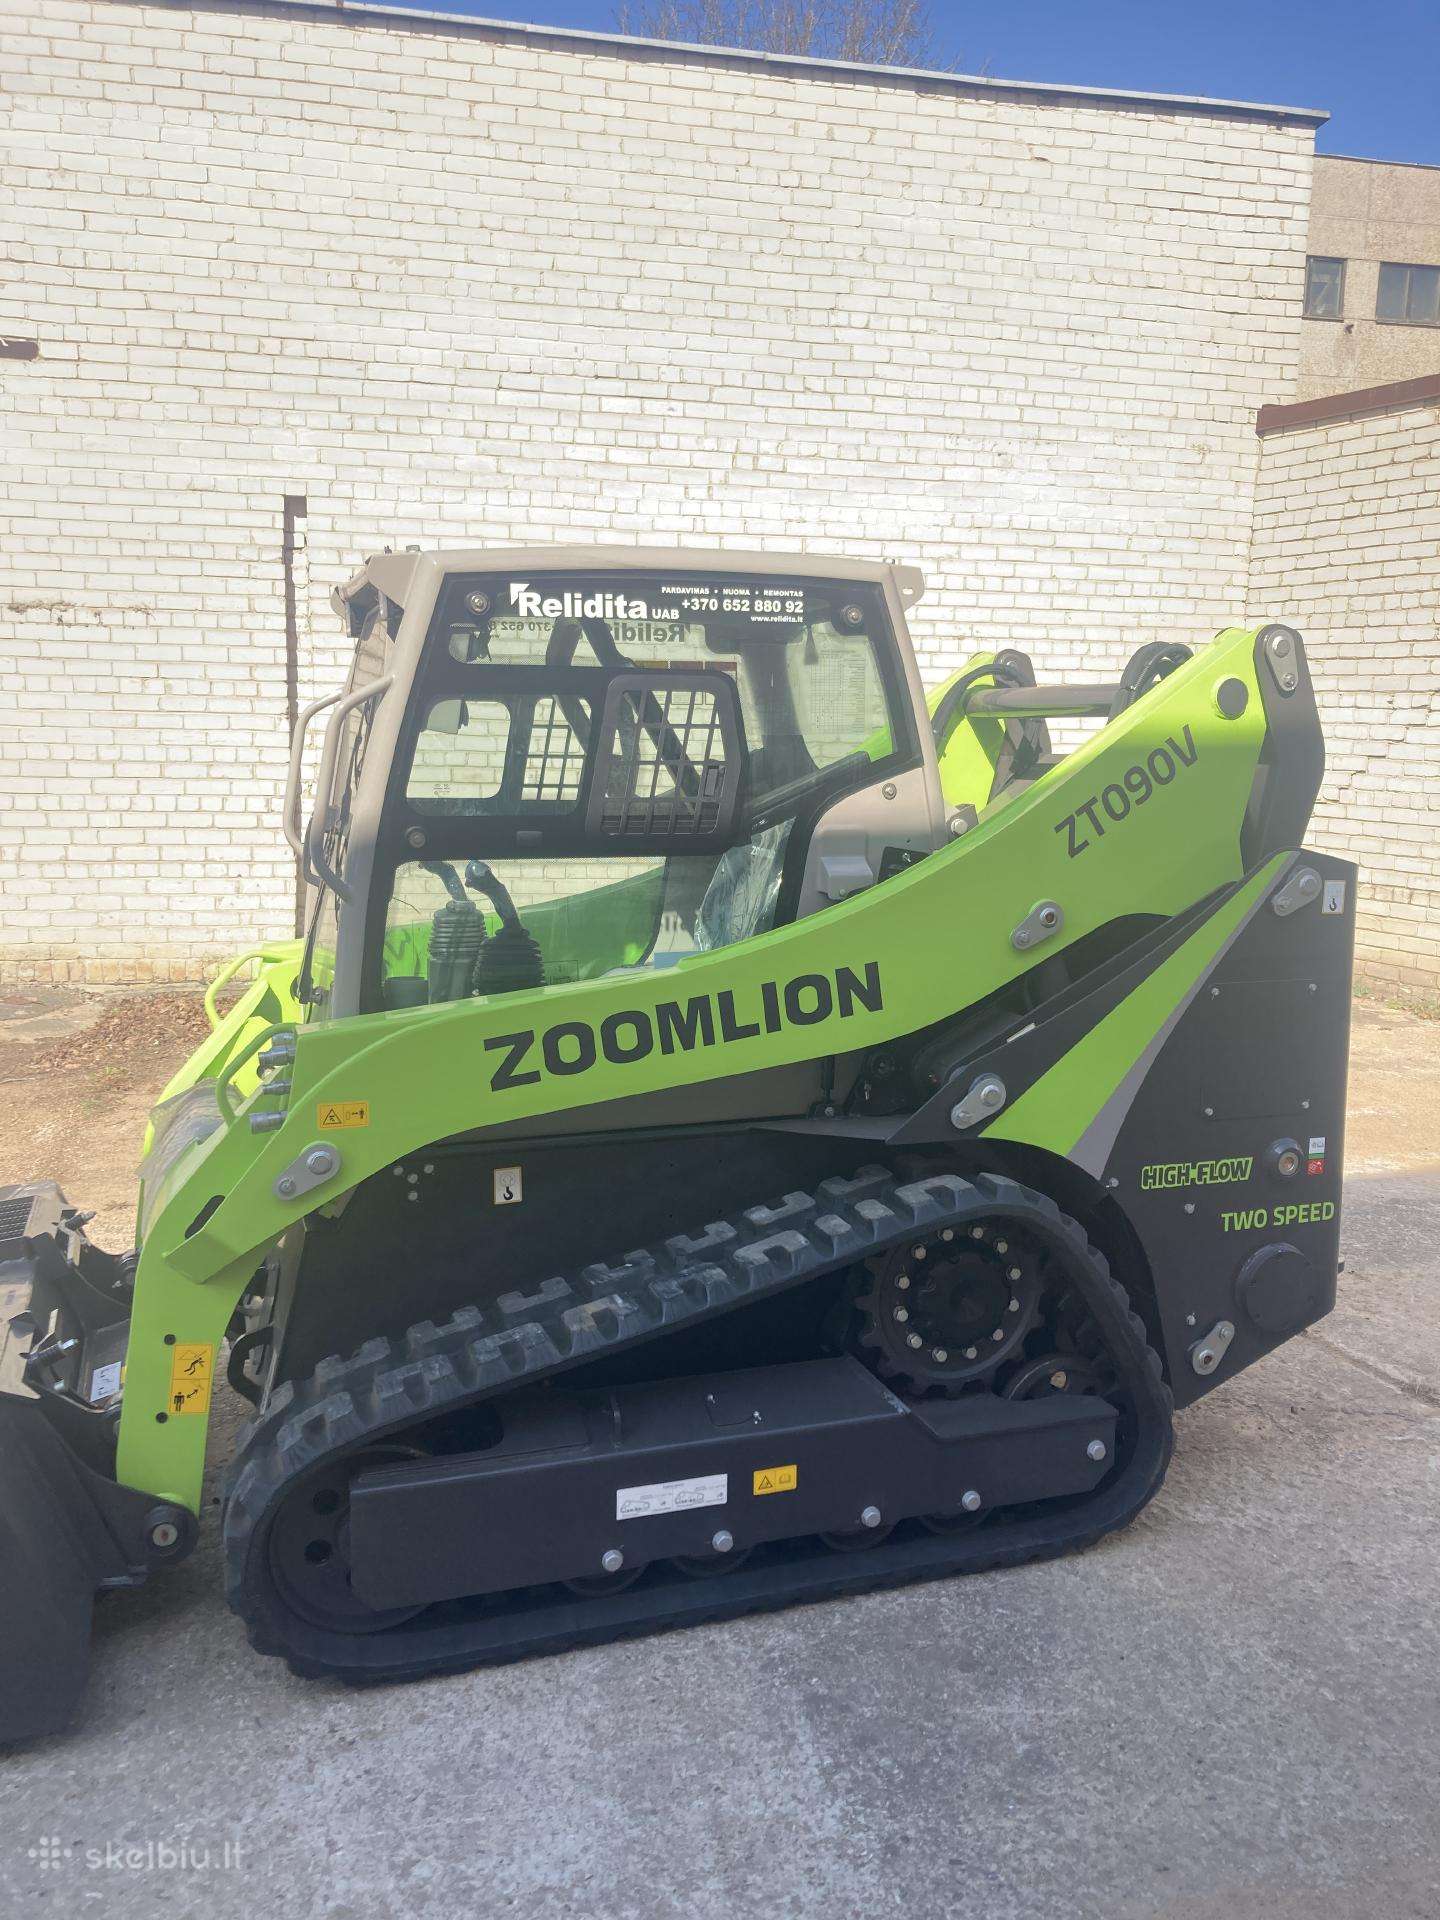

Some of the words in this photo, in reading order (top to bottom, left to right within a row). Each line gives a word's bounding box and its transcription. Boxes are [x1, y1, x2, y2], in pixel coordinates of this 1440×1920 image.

[518, 591, 648, 619] Relidita
[652, 608, 680, 620] UAB
[661, 586, 710, 595] PARDAVIMAS
[723, 588, 751, 596] NUOMA
[763, 589, 804, 597] REMONTAS
[682, 598, 719, 611] +370
[722, 599, 750, 612] 652
[754, 600, 782, 613] 880
[785, 601, 804, 613] 92
[750, 615, 804, 623] www.relidita.lt
[1054, 724, 1198, 858] ZT090V
[483, 961, 884, 1092] ZOOMLION
[1221, 1208, 1268, 1232] TWO
[1273, 1201, 1335, 1226] SPEED
